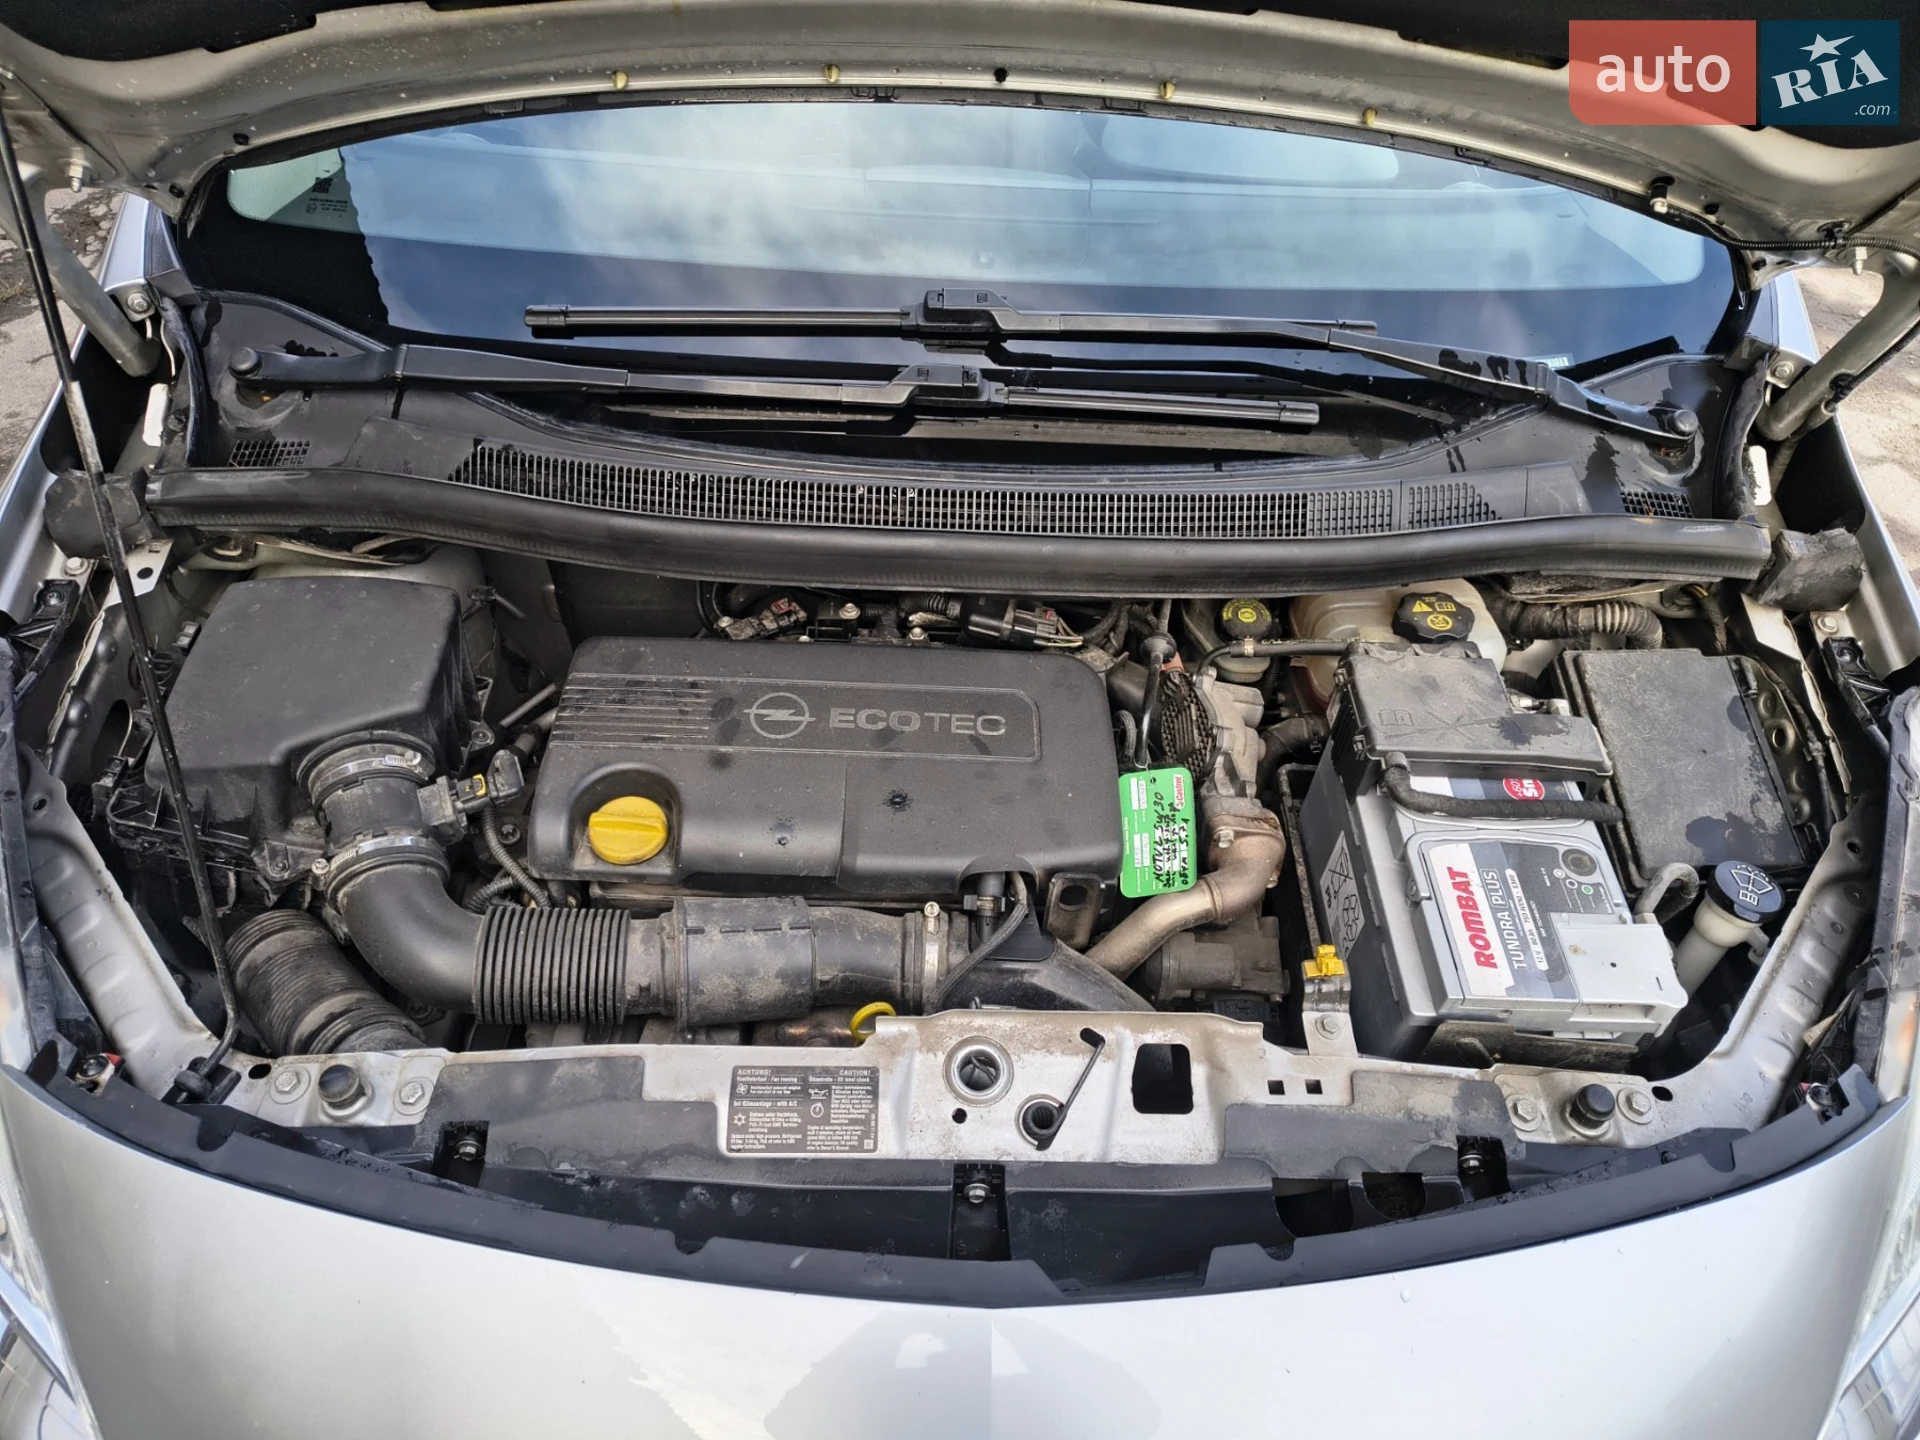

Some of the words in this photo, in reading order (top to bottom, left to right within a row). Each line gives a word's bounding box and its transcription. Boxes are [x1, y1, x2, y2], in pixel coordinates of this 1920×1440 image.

[830, 707, 1006, 736] ECOTEC
[1485, 872, 1503, 904] PLUS
[1446, 866, 1498, 969] ROMBAT
[1499, 911, 1527, 969] TUNDRA
